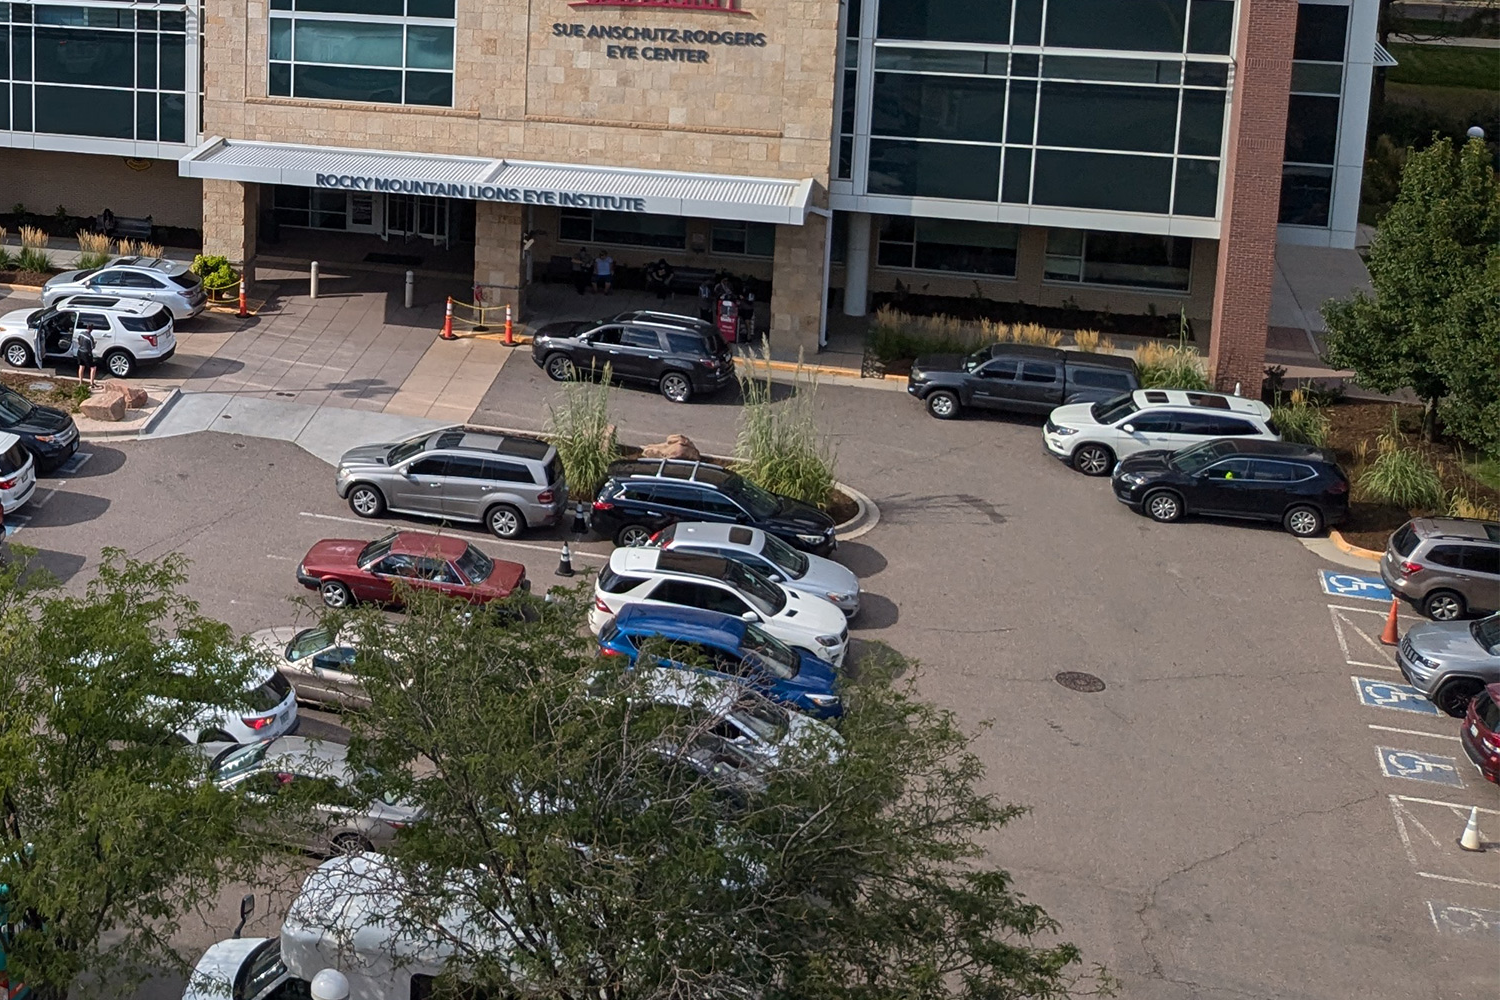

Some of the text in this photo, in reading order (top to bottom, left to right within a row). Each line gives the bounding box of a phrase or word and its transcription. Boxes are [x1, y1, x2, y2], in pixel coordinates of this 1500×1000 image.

[553, 23, 766, 46] SUE ANSCHUTZ-RODGERS
[607, 45, 709, 63] EYE CENTER
[316, 173, 646, 211] ROCKY MOUNTAIN LIONS EYE INSTITUTE
